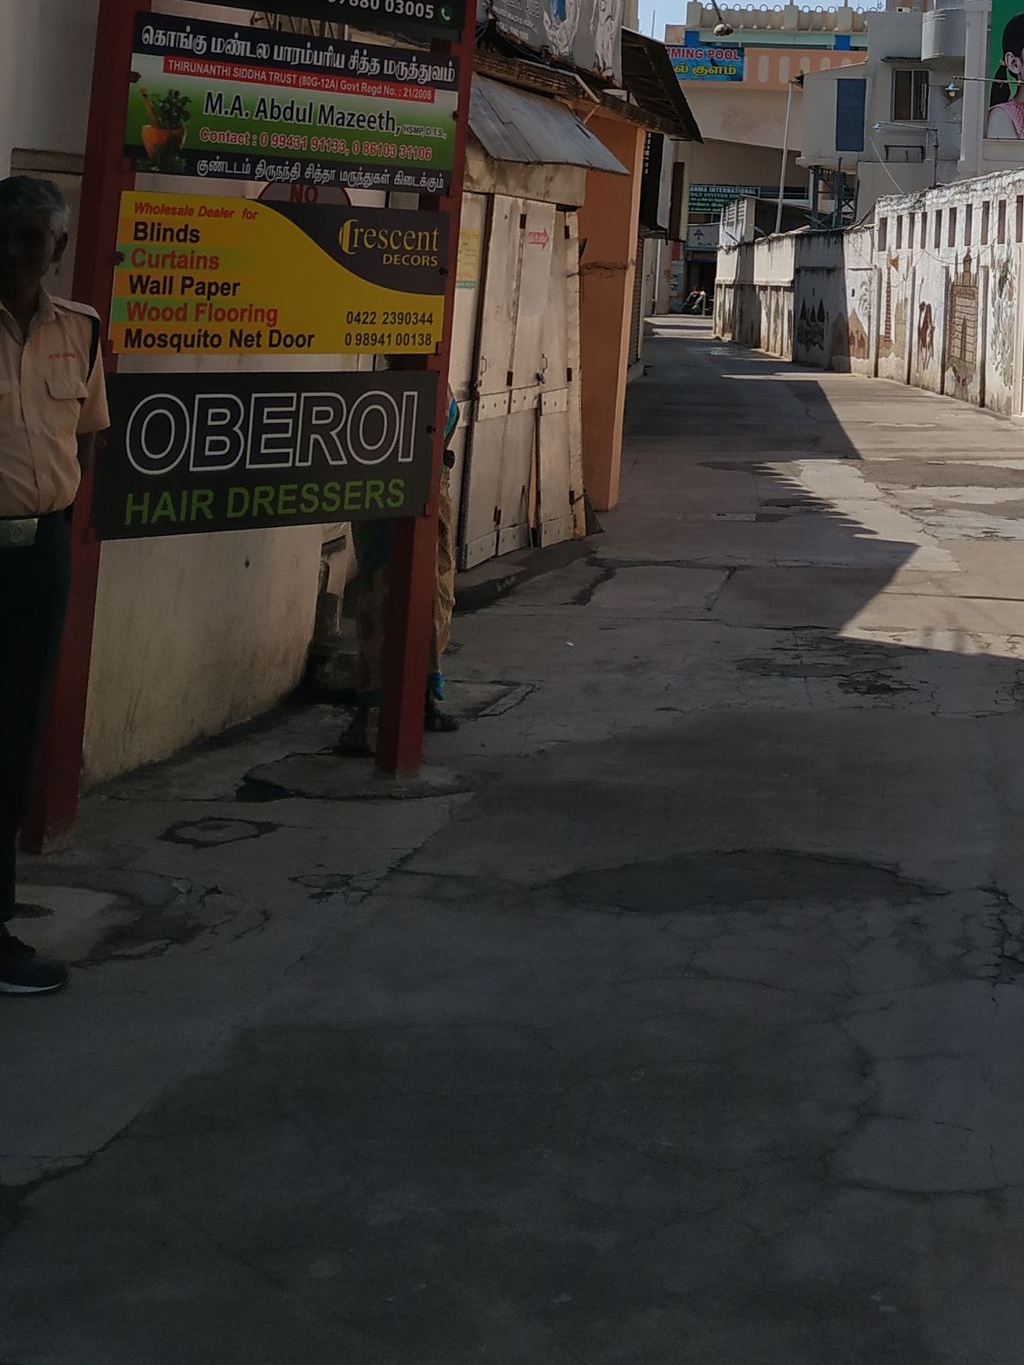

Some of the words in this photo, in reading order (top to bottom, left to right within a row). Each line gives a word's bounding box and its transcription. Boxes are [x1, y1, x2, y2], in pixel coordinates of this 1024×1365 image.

[142, 25, 208, 55] கொங்கு
[211, 32, 271, 60] மண்டல
[273, 41, 345, 68] பாரம்பரிய
[348, 48, 381, 76] சித்த
[668, 47, 704, 59] MING
[707, 49, 740, 60] POOL
[168, 59, 231, 76] THIRUNANTHI
[233, 67, 267, 81] SIDDHA
[268, 73, 298, 85] TRUST
[204, 91, 250, 118] M.A.
[254, 97, 313, 124] Abdul
[318, 104, 402, 135] Mazeeth,
[200, 127, 250, 145] Contact
[133, 202, 194, 218] Wholesale
[198, 205, 234, 219] Dealer
[242, 208, 258, 220] for
[132, 221, 200, 244] Blinds
[338, 218, 439, 255] Crescent
[131, 248, 220, 270] Curtains
[382, 253, 438, 267] DECORS
[129, 275, 174, 295] Wall
[180, 276, 240, 300] Paper
[126, 301, 188, 323] Wood
[194, 302, 279, 327] Flooring
[346, 311, 376, 325] 0422
[382, 311, 434, 325] 2390344
[124, 328, 222, 351] Mosquito
[228, 329, 262, 347] Net
[268, 329, 315, 348] Door
[125, 390, 419, 476] OBEROI
[124, 488, 214, 525] HAIR
[226, 478, 406, 519] DRESSERS
